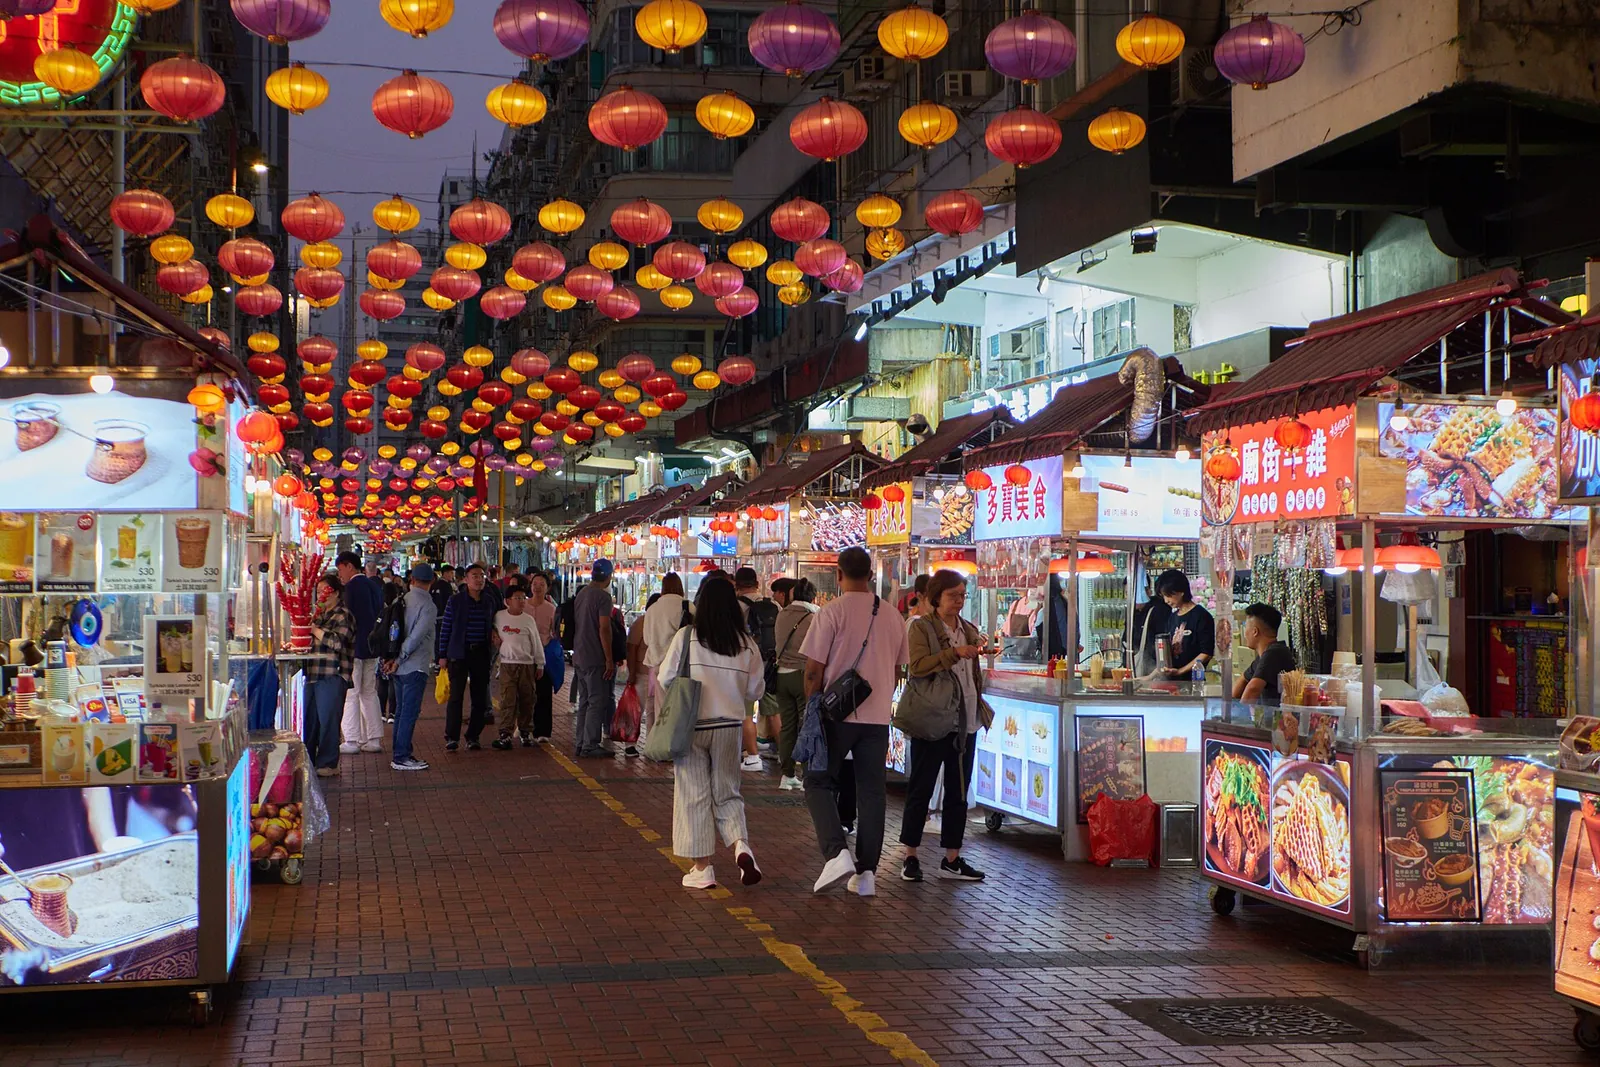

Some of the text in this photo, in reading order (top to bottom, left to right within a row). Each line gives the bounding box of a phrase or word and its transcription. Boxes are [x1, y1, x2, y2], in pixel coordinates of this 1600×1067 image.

[986, 474, 1048, 525] 多寶美食
[139, 567, 155, 576] $30
[203, 567, 220, 576] $30
[186, 674, 203, 682] $30
